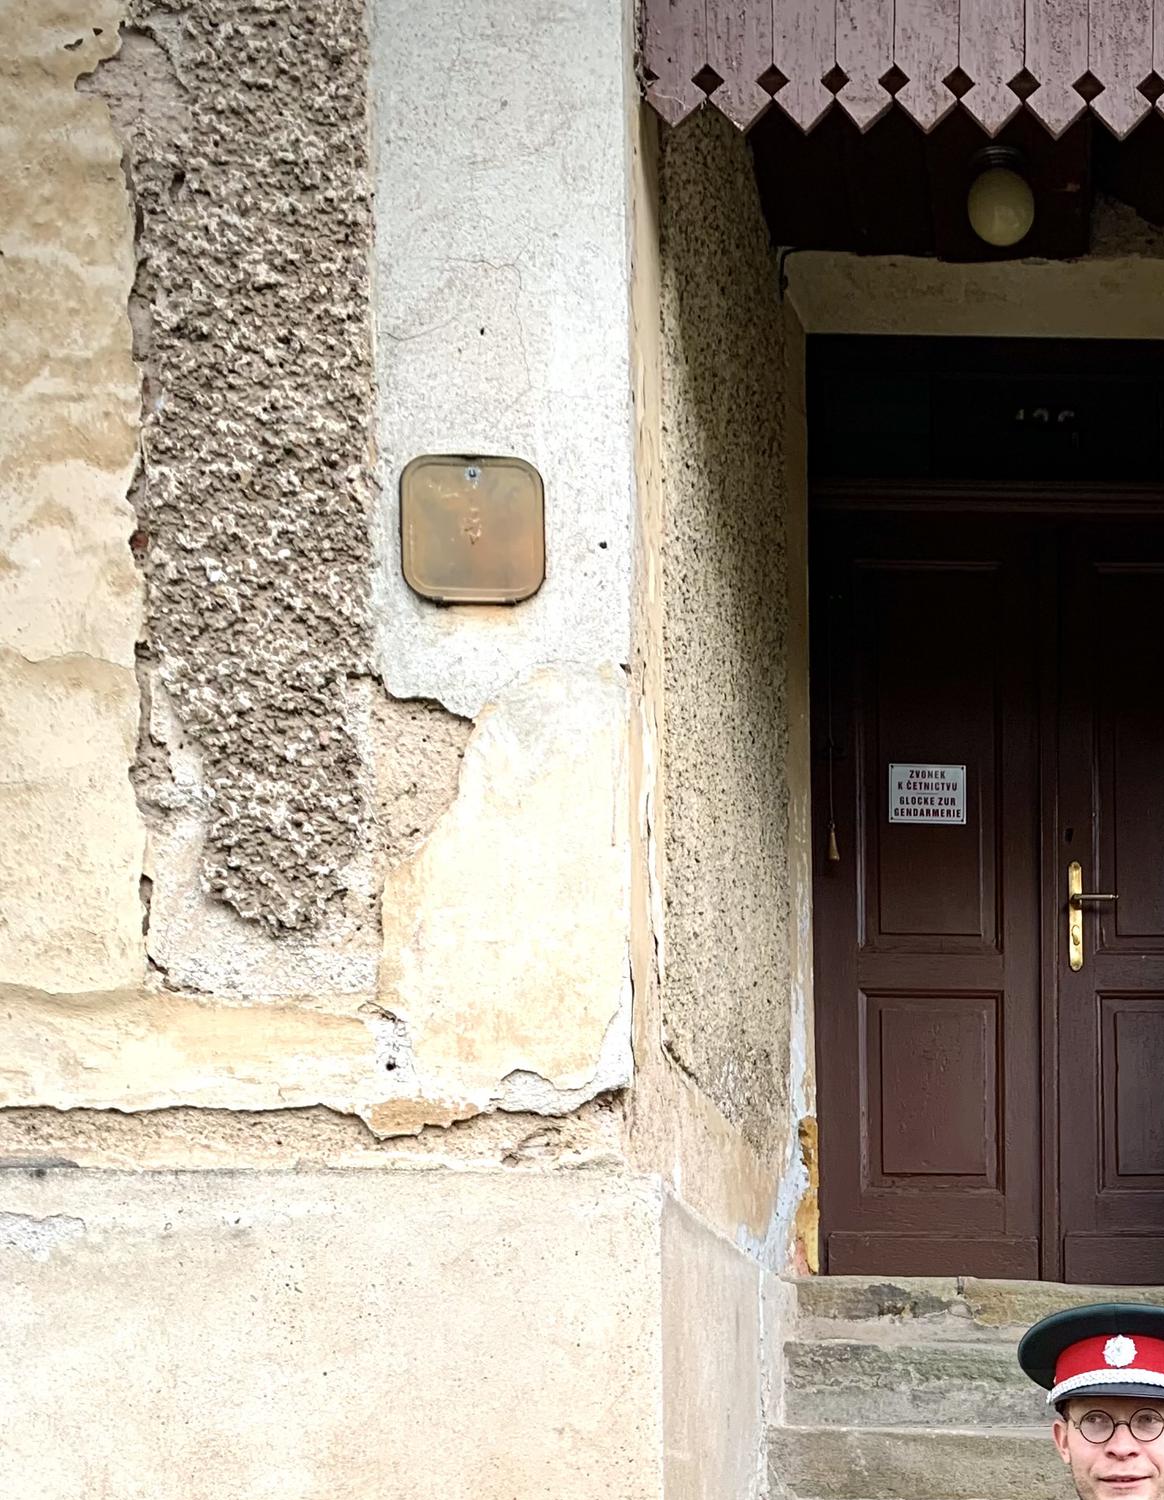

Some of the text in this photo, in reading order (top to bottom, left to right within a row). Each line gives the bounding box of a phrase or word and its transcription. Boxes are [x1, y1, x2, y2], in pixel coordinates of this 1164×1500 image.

[909, 769, 946, 779] ZVONEK
[897, 780, 958, 791] K ČETNICTVU
[899, 796, 956, 806] GLOCKE ZUR
[893, 807, 961, 818] GENDARMERIE
